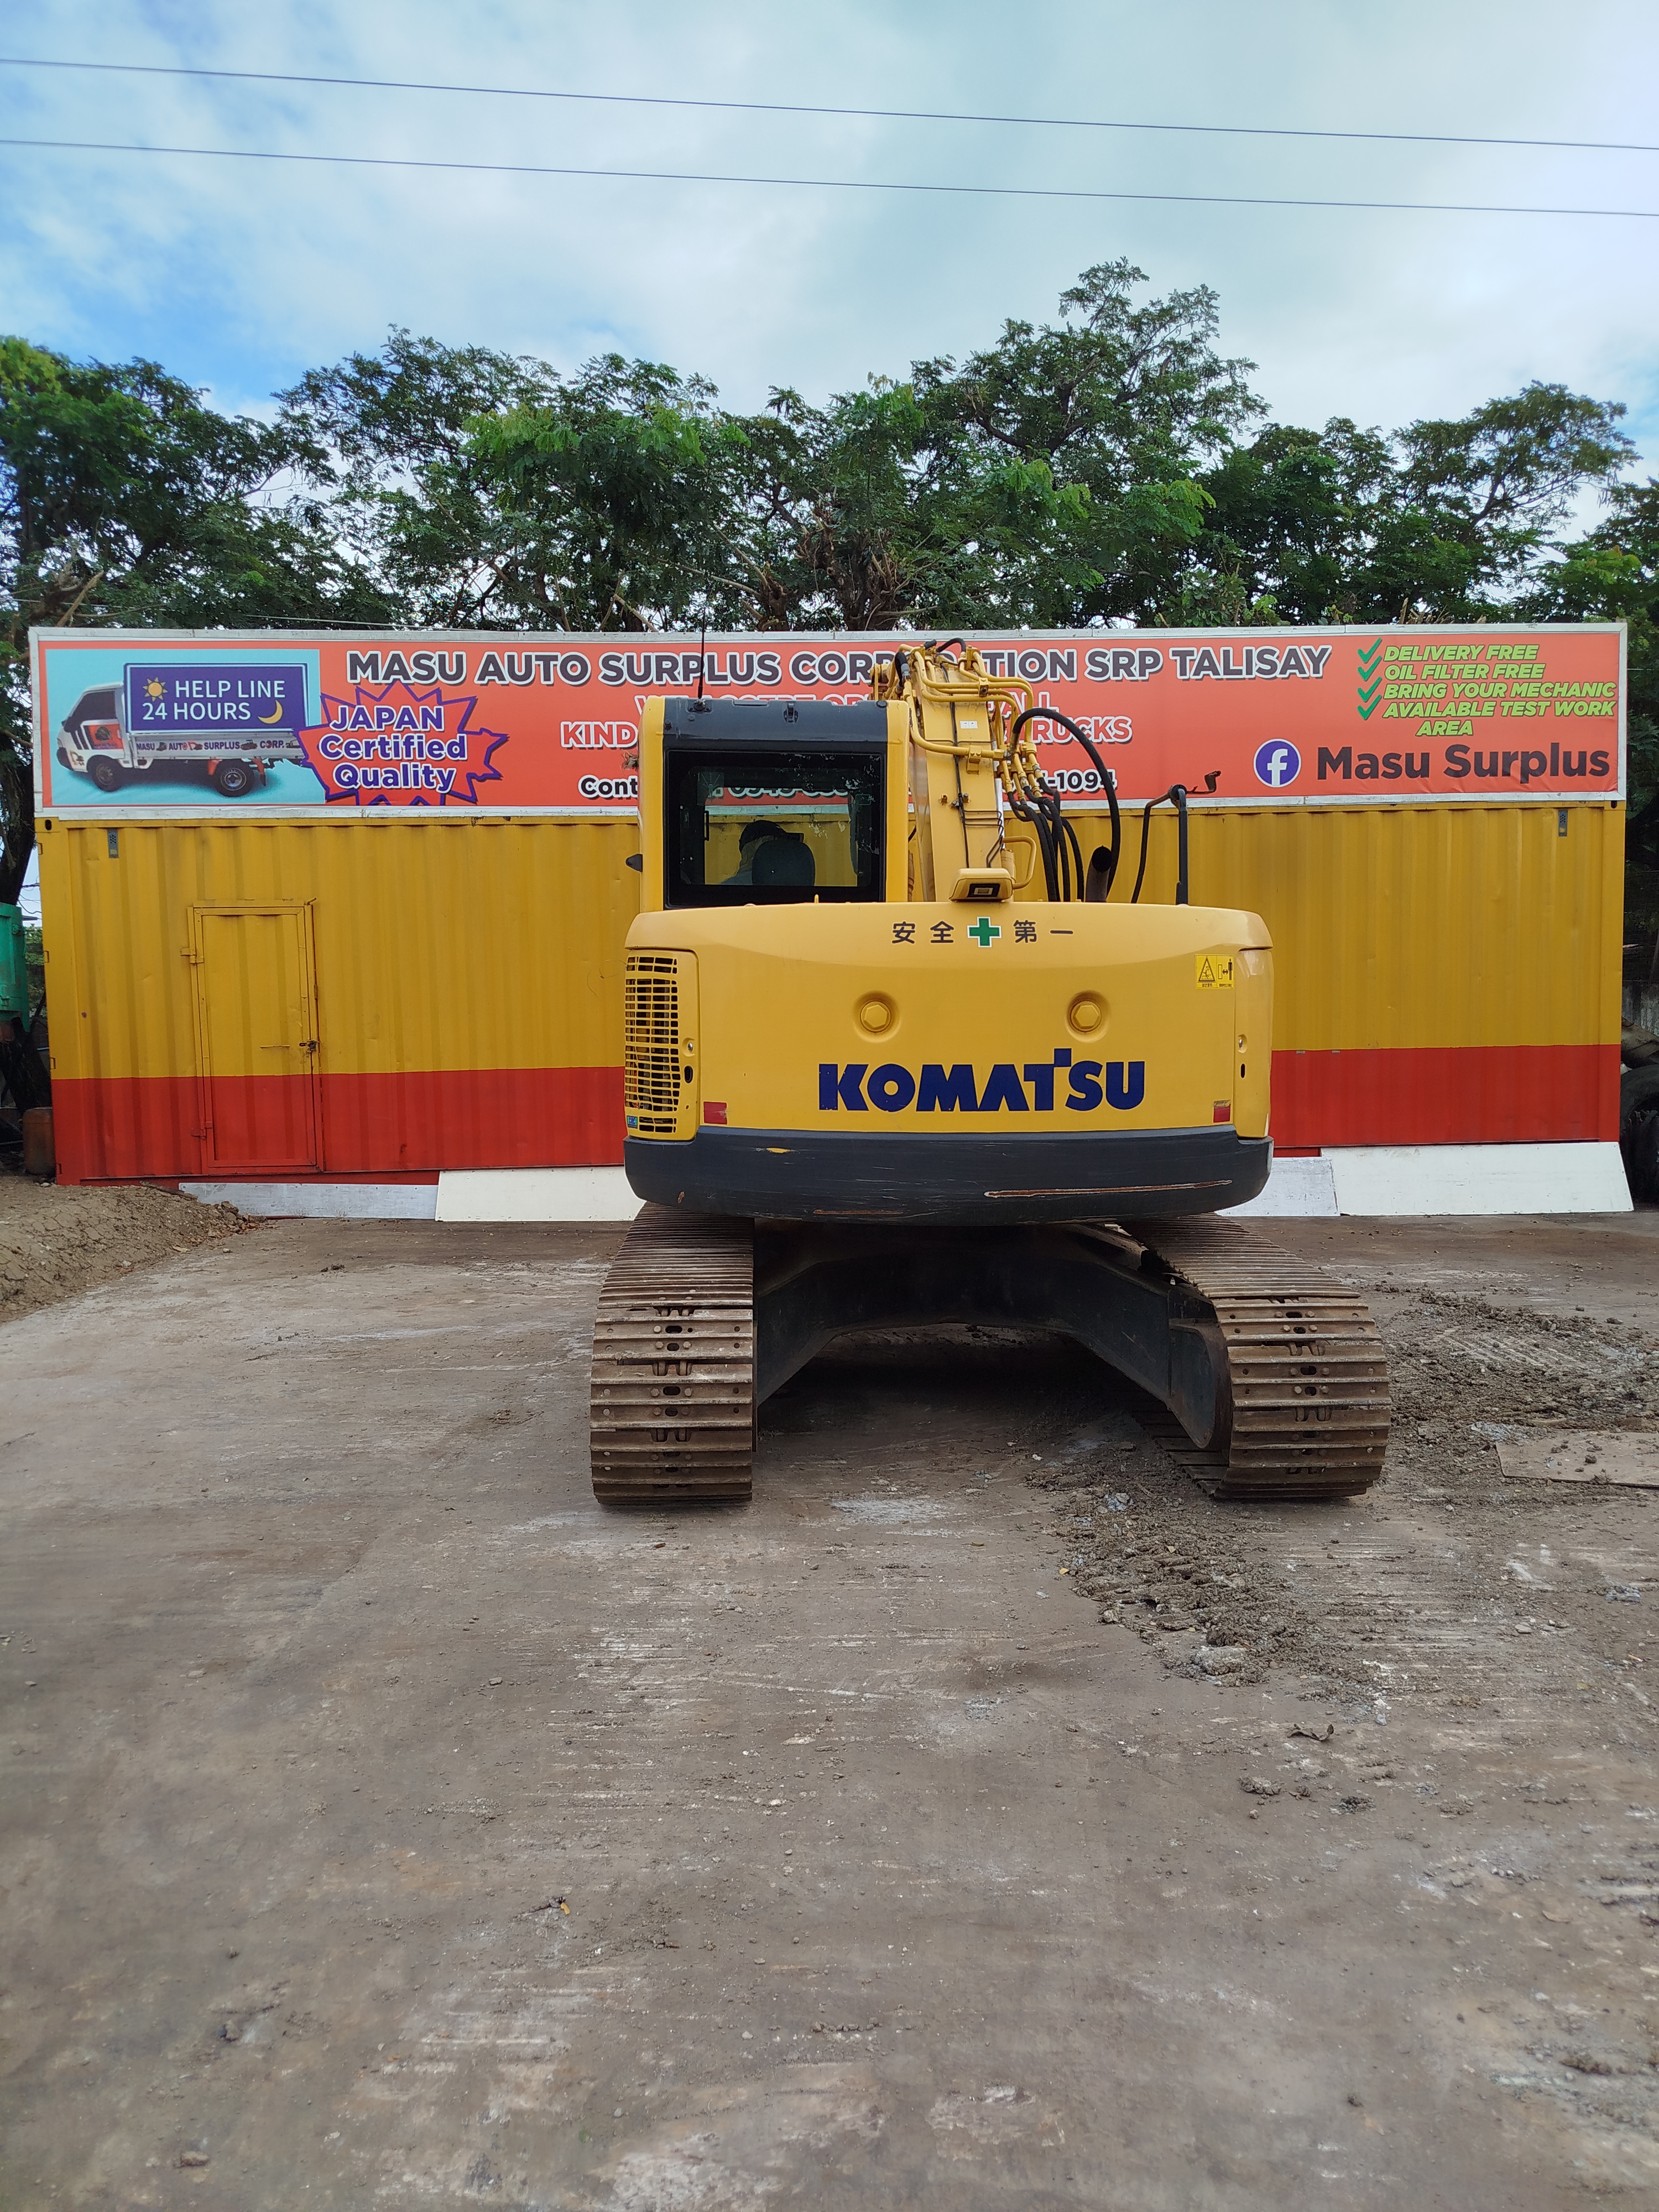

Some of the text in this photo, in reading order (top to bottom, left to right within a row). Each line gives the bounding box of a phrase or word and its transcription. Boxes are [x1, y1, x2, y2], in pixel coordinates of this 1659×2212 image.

[1384, 645, 1539, 662] DELIVERY FREE
[347, 645, 1332, 685] MASU AUTO SURPLUS CORTION SRP TALISAY
[1384, 664, 1546, 681] OIL FILTER FREE
[175, 680, 285, 698] HELP LINE
[1383, 682, 1616, 700] BRING YOUR MECHANIC
[142, 702, 251, 721] 24 HOURS
[329, 705, 444, 732] JAPAN
[1383, 701, 1616, 718] AVAILABLE TEST WORK
[1018, 716, 1132, 744] RUCKS
[1416, 720, 1474, 736] AREA
[204, 742, 240, 750] SURPLUS
[259, 740, 285, 749] CORP.
[319, 734, 467, 760] Certified
[1317, 743, 1610, 784] Masu Surplus
[333, 763, 457, 793] Quality
[578, 775, 638, 798] Cont
[819, 1048, 1145, 1112] KOMATSU
